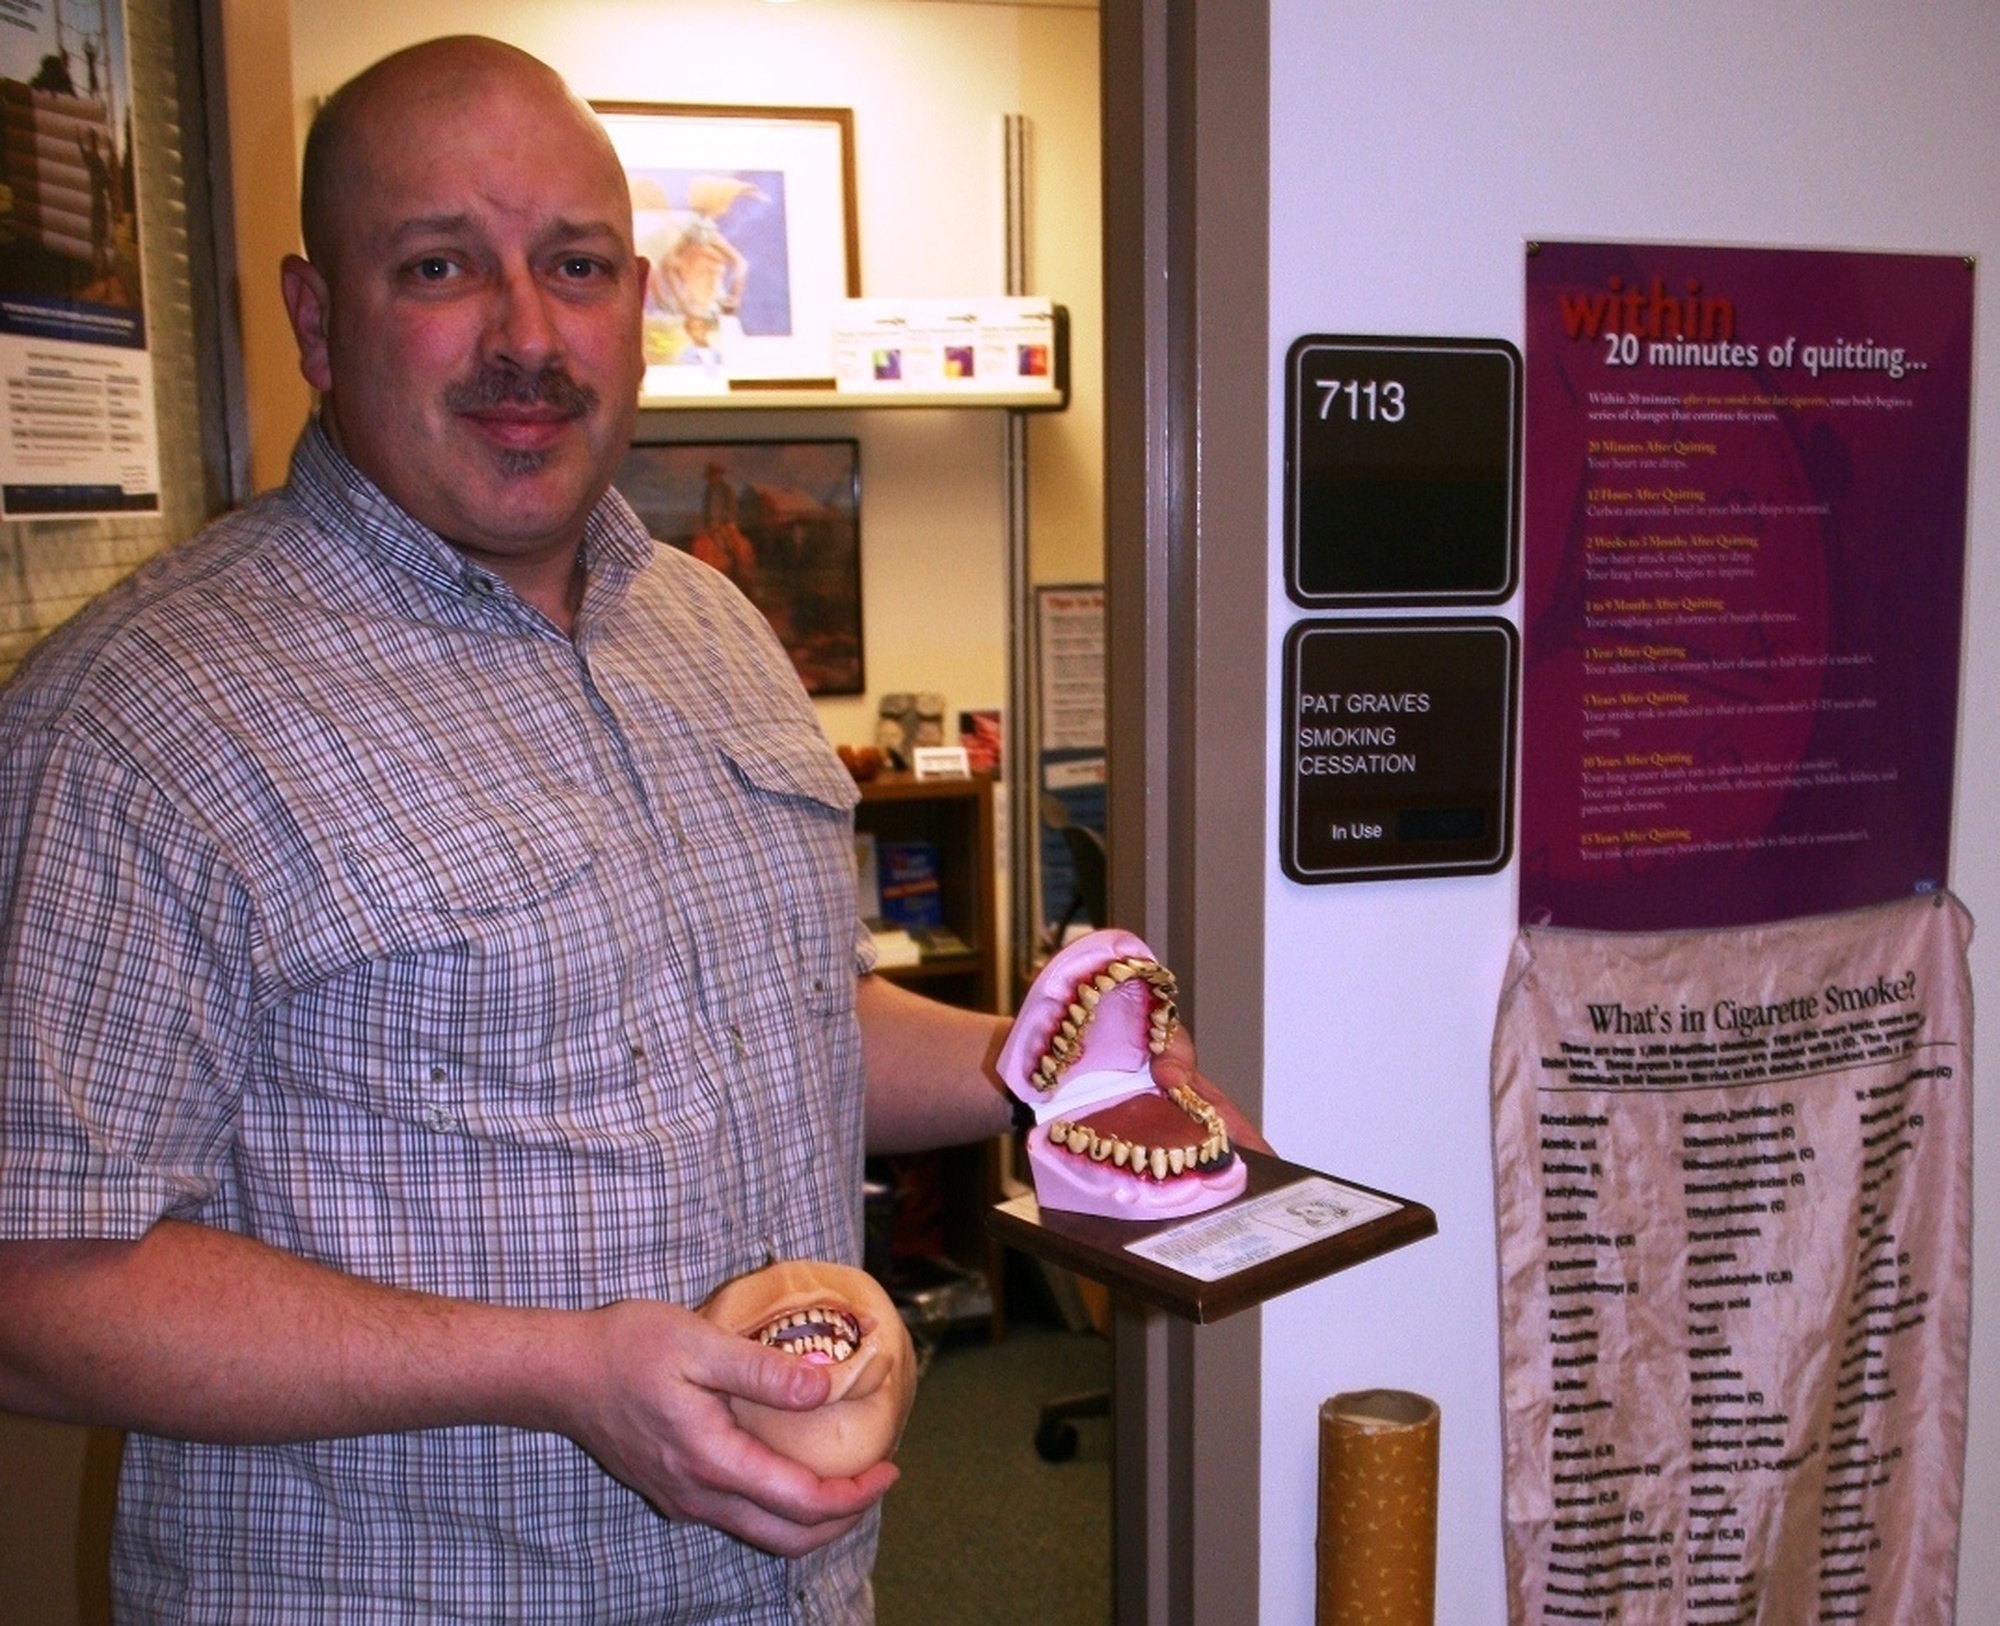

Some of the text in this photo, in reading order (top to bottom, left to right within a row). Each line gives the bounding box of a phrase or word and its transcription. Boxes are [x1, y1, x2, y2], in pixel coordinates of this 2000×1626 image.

[1560, 276, 1736, 340] within
[1605, 333, 1928, 378] 20 minutes of quitting...
[1315, 380, 1405, 422] 7113
[1589, 393, 1625, 404] Within
[1642, 394, 1680, 405] minutes
[1618, 411, 1629, 420] of
[1631, 411, 1669, 423] changes
[1672, 410, 1690, 420] that
[1693, 411, 1733, 420] continue
[1737, 410, 1749, 420] for
[1674, 441, 1716, 455] Quitting
[1663, 488, 1706, 502] Quitting
[1595, 537, 1626, 548] Weeks
[1650, 536, 1687, 547] Months
[1691, 535, 1713, 547] After
[1716, 534, 1758, 549] Quitting
[1682, 597, 1724, 611] Quitting
[1643, 645, 1686, 660] Quitting
[1301, 693, 1430, 713] PAT GRAVES
[1646, 692, 1690, 705] Quitting
[1300, 727, 1396, 748] SMOKING
[1300, 754, 1416, 775] CESSATION
[1650, 753, 1693, 767] Quitting
[1332, 822, 1382, 840] In Use
[1649, 829, 1691, 844] Quitting
[1587, 971, 1916, 1036] What's in Cigarette Smoke?
[1612, 1047, 1635, 1056] over
[1669, 1042, 1716, 1054] identified
[1809, 1041, 1831, 1054] with
[1622, 1073, 1643, 1085] that
[1710, 1070, 1730, 1081] risk
[1826, 1051, 1865, 1065] marked
[1868, 1045, 1892, 1059] with
[1688, 1274, 1763, 1289] Formaldehyde
[1688, 1298, 1751, 1313] Formic acid
[1747, 1391, 1765, 1406] (C)
